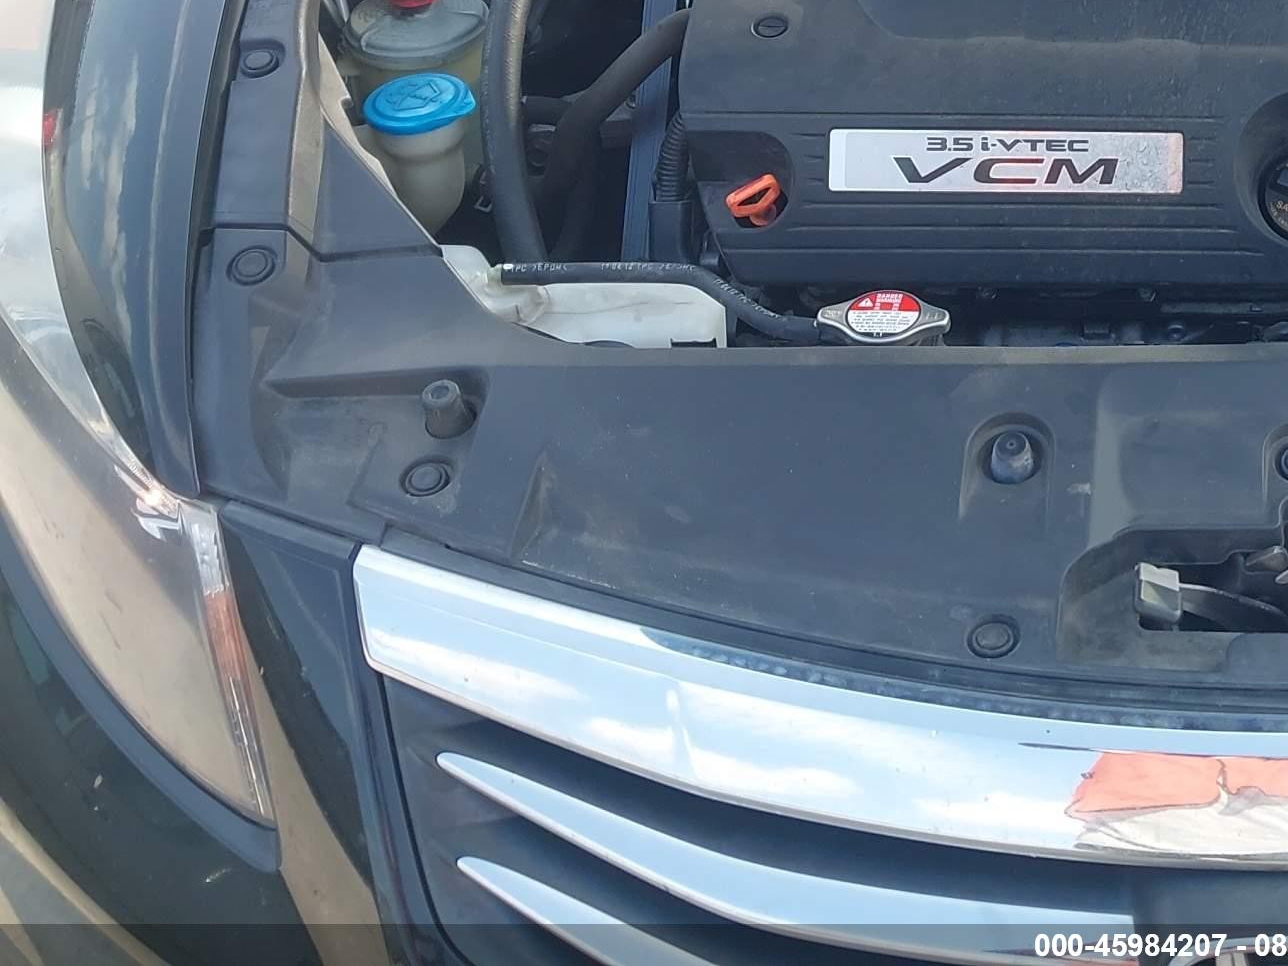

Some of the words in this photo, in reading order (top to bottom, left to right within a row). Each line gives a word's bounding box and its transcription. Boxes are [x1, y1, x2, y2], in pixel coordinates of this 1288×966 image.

[926, 136, 974, 152] 3.5
[981, 136, 1090, 152] i-VTEC
[893, 156, 1119, 185] VCM
